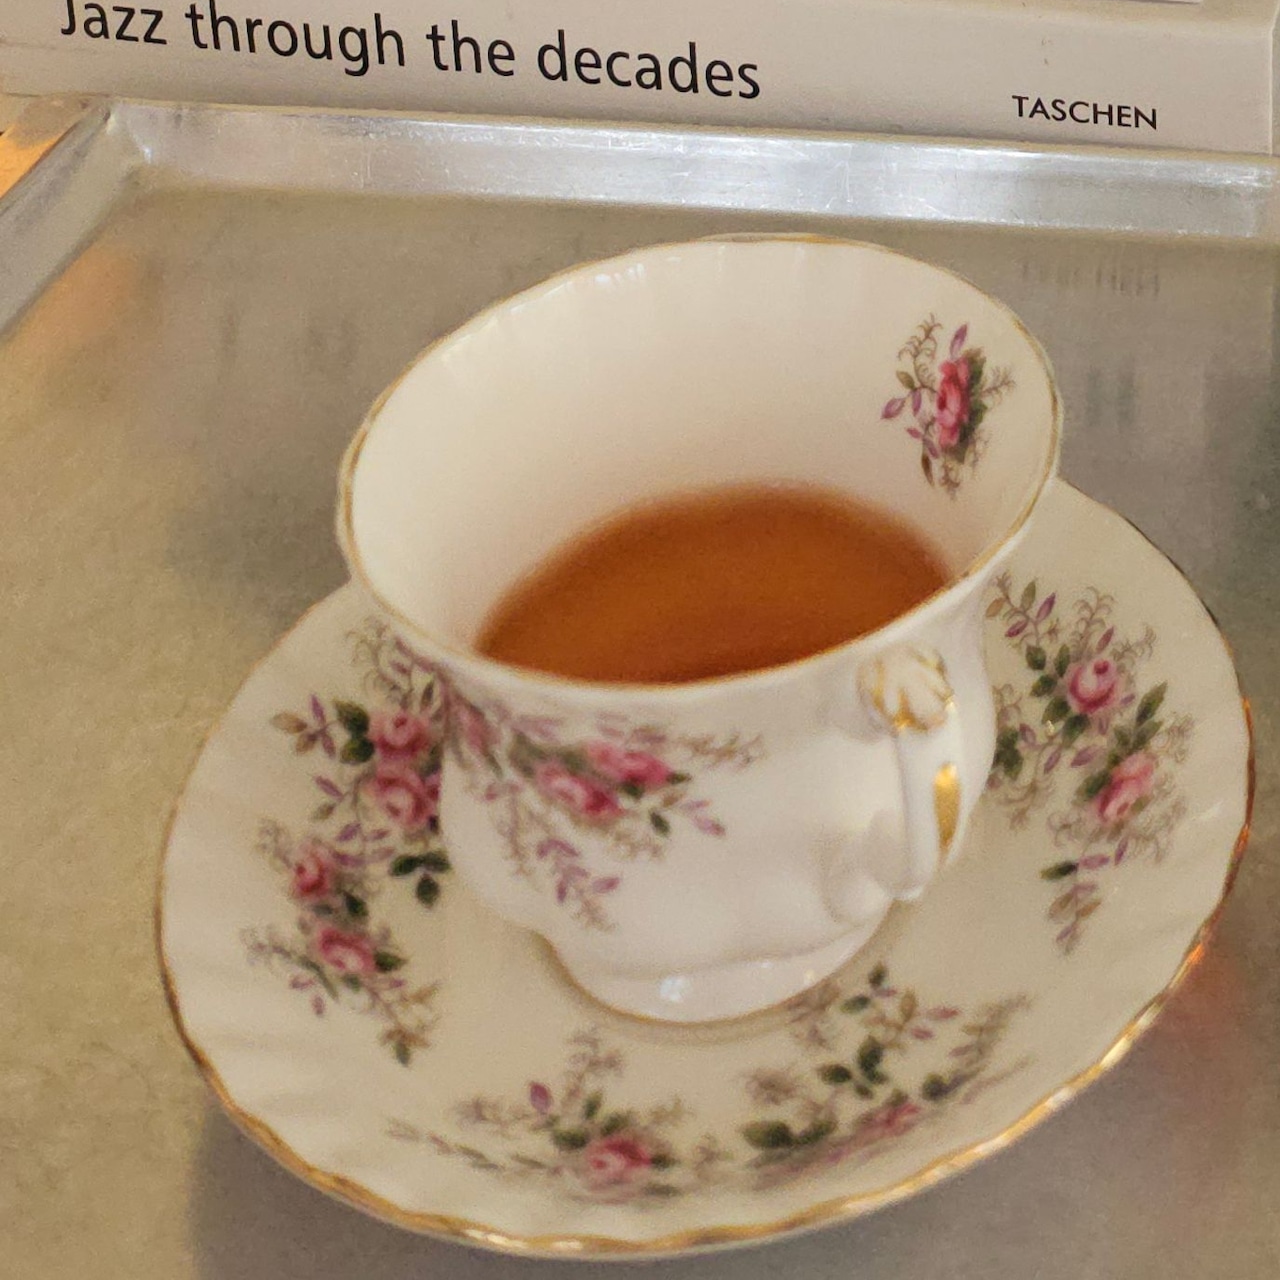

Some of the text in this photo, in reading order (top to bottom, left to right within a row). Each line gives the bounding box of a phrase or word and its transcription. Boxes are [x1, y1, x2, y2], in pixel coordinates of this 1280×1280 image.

[425, 19, 516, 77] the
[537, 29, 761, 100] decades
[1011, 95, 1157, 131] TASCHEN
